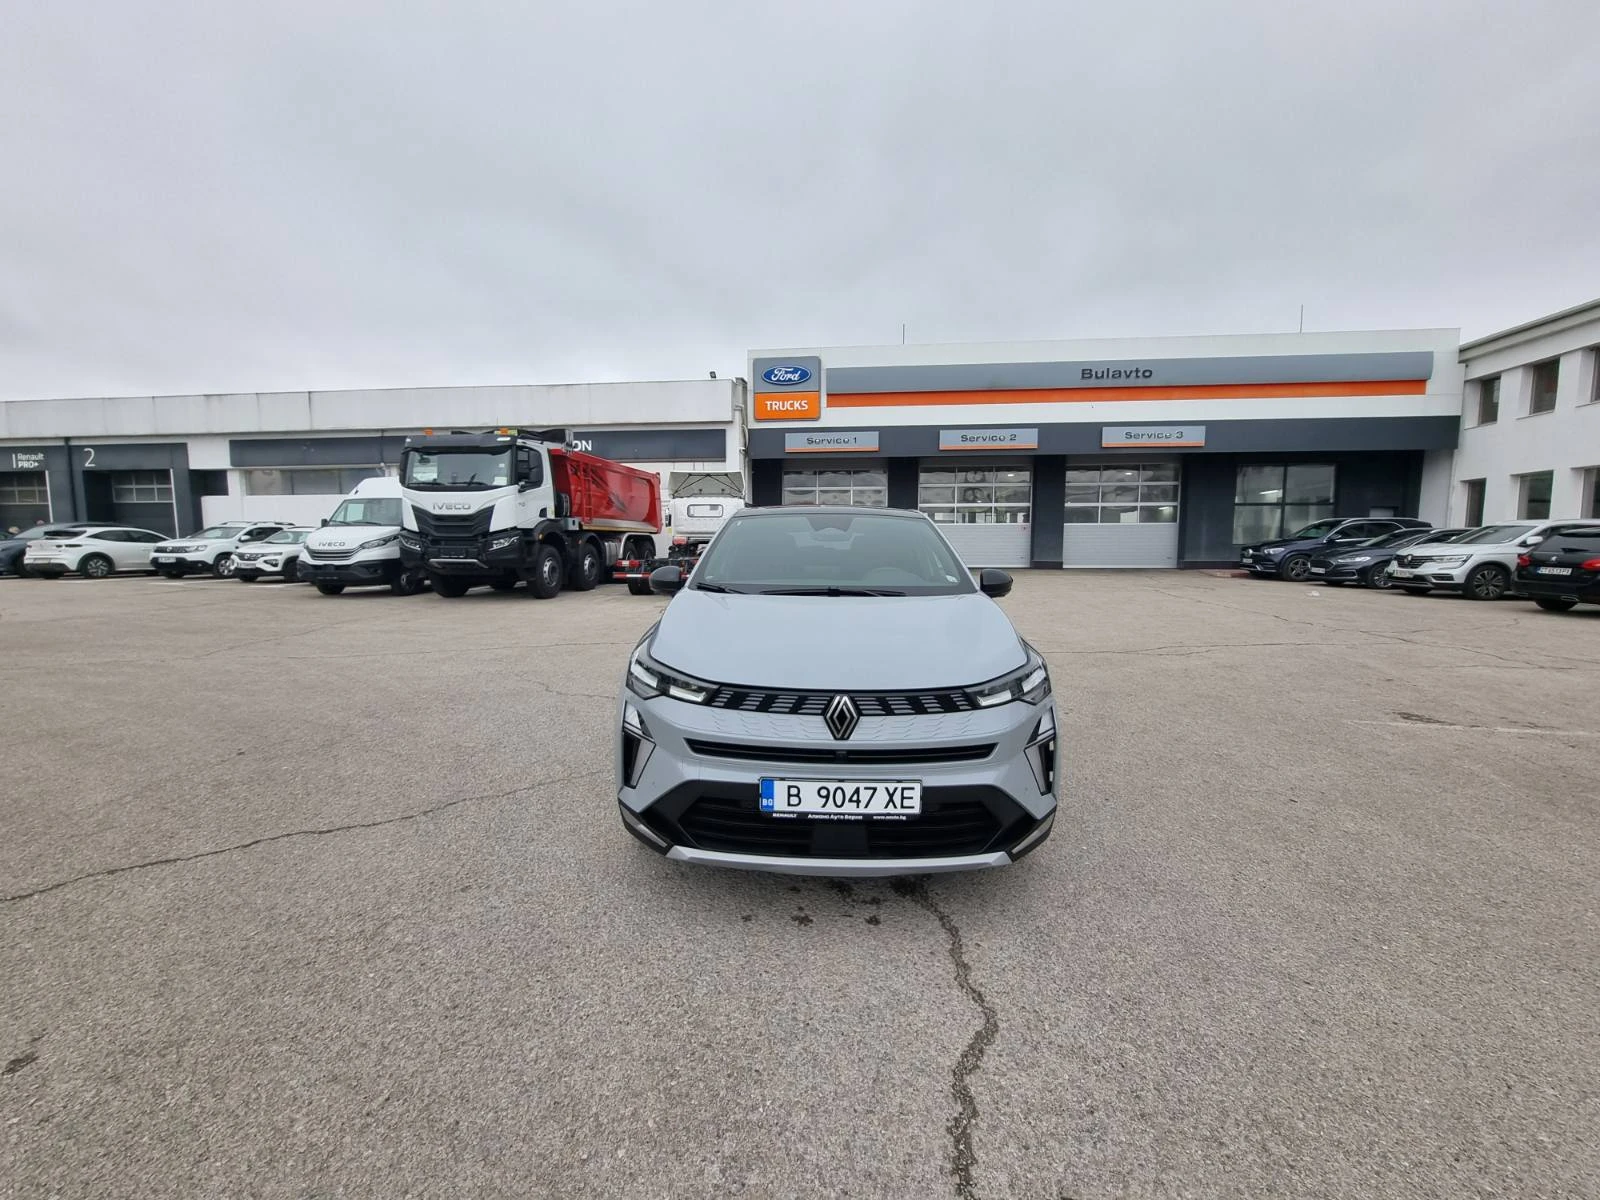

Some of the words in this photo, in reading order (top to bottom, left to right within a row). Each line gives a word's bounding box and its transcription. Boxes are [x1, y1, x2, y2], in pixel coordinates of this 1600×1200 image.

[771, 367, 801, 381] Ford
[1081, 367, 1153, 380] Bulavto
[764, 399, 809, 412] TRUCKS
[806, 436, 851, 445] Service
[852, 436, 858, 444] 1
[961, 433, 1006, 443] Service
[1009, 433, 1017, 441] 2
[1124, 430, 1173, 440] Service
[1175, 430, 1184, 439] 3
[17, 452, 44, 461] Renault
[83, 447, 96, 467] 2
[432, 502, 472, 511] IVECO
[787, 785, 802, 807] B
[817, 786, 878, 809] 9047
[883, 786, 915, 809] XE
